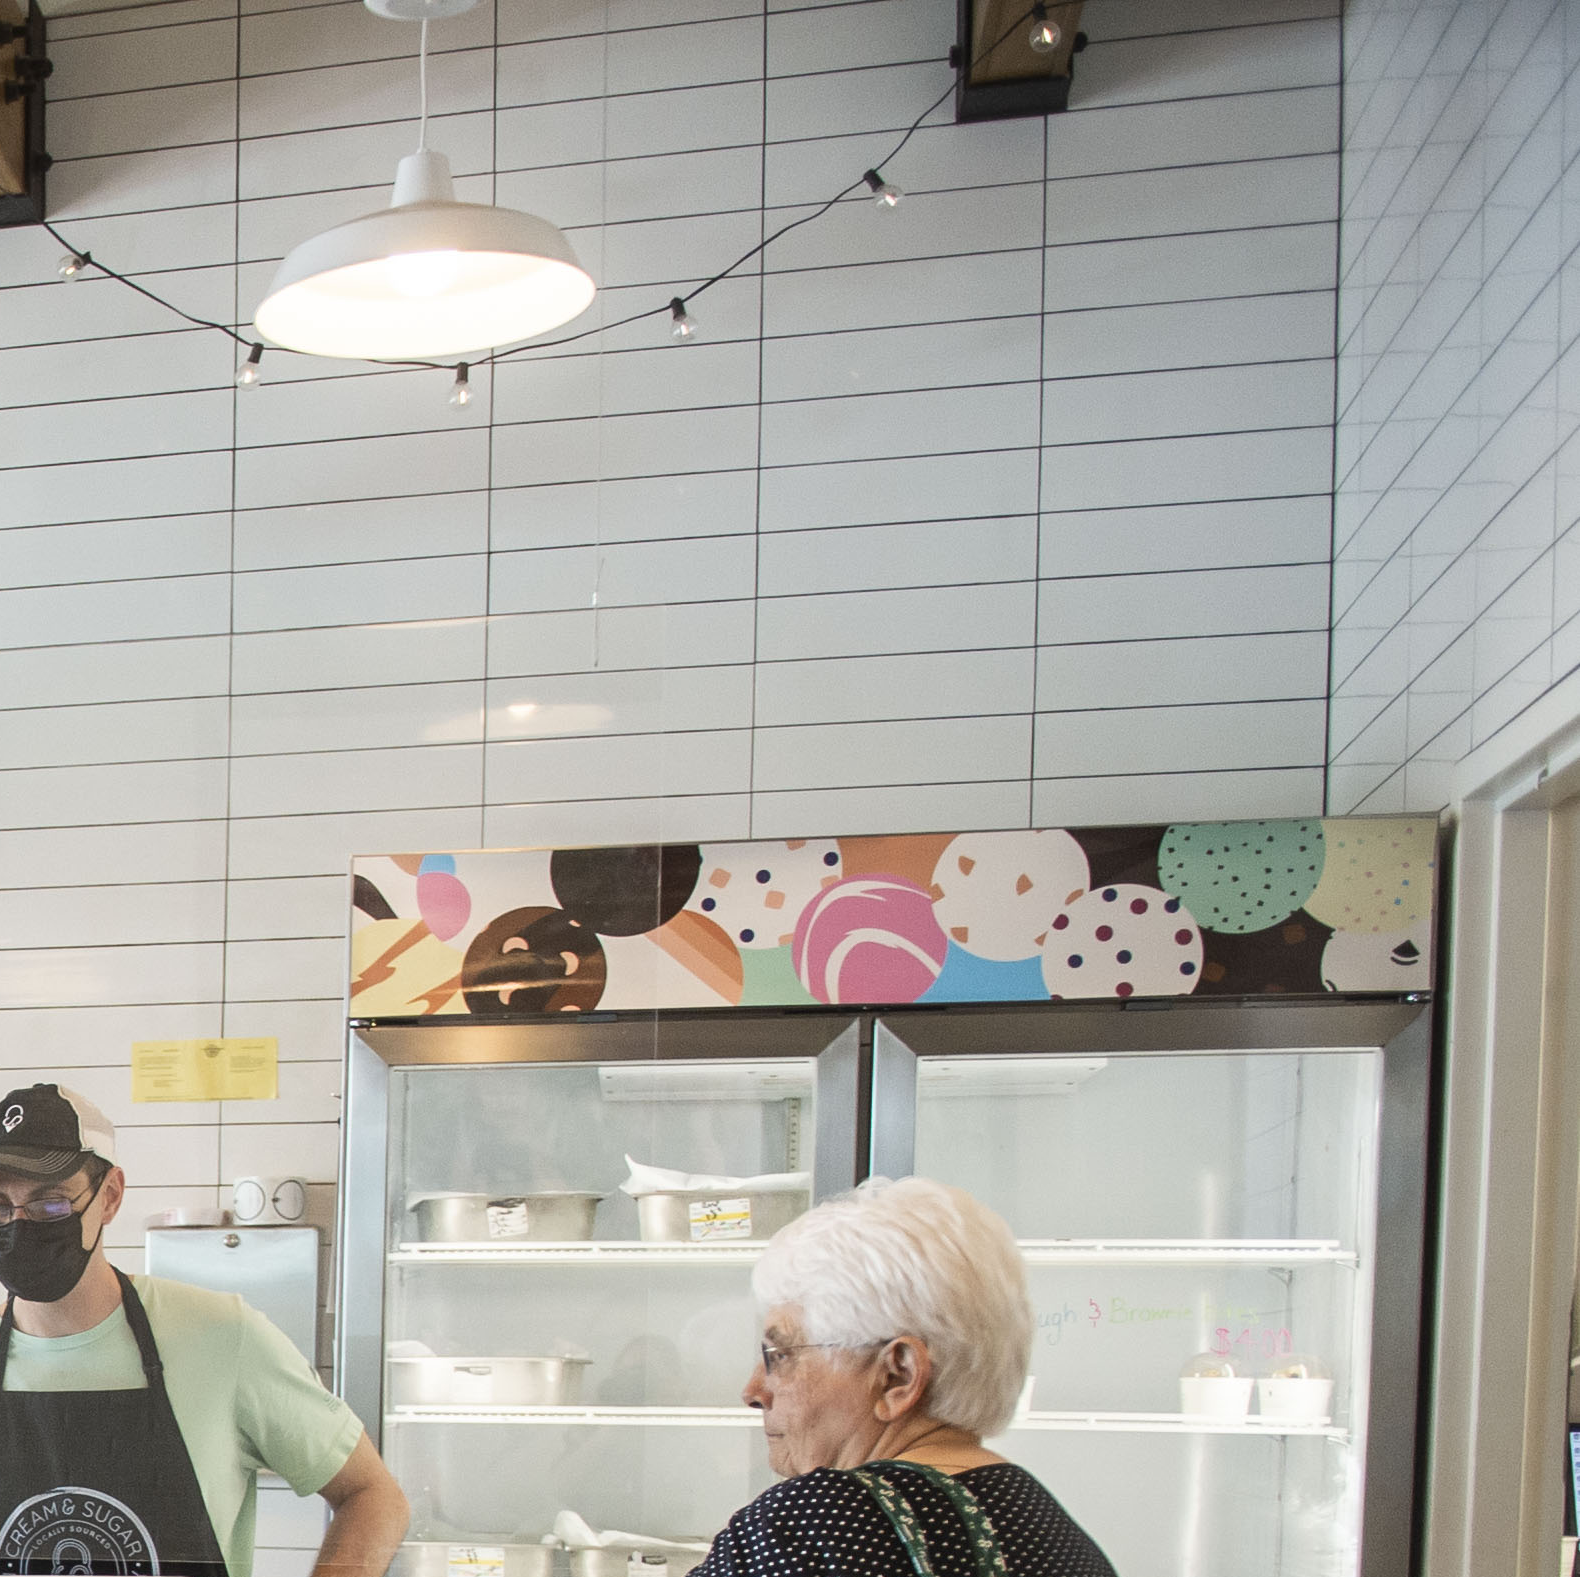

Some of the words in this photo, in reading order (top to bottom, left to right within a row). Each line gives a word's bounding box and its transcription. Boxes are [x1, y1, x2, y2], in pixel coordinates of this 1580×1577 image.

[5, 1501, 59, 1558] CREAM
[61, 1498, 75, 1515] &
[82, 1501, 142, 1557] SUGAR
[32, 1527, 65, 1550] LOCALLY
[70, 1526, 111, 1550] SOURCED
